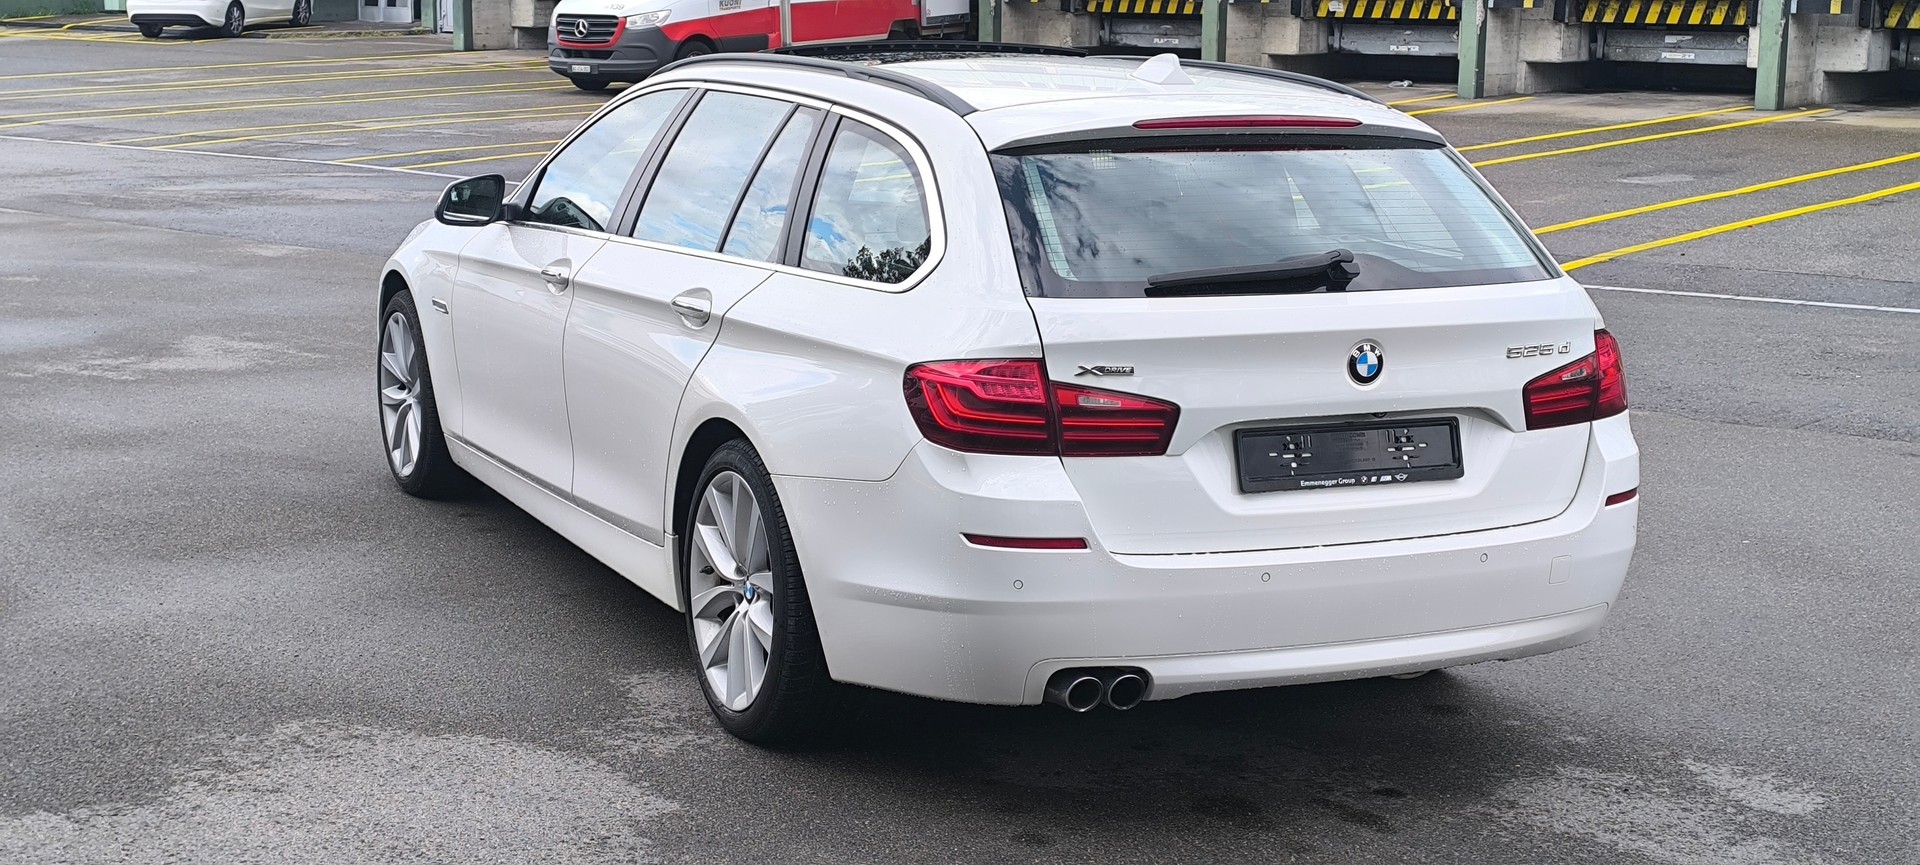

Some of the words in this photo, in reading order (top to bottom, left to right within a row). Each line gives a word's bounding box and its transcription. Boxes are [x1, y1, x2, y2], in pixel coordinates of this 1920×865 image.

[1352, 344, 1381, 358] BMW
[1506, 344, 1554, 359] 525
[1558, 341, 1571, 354] d
[1300, 479, 1338, 487] Emmenegger
[1338, 477, 1356, 485] Group
